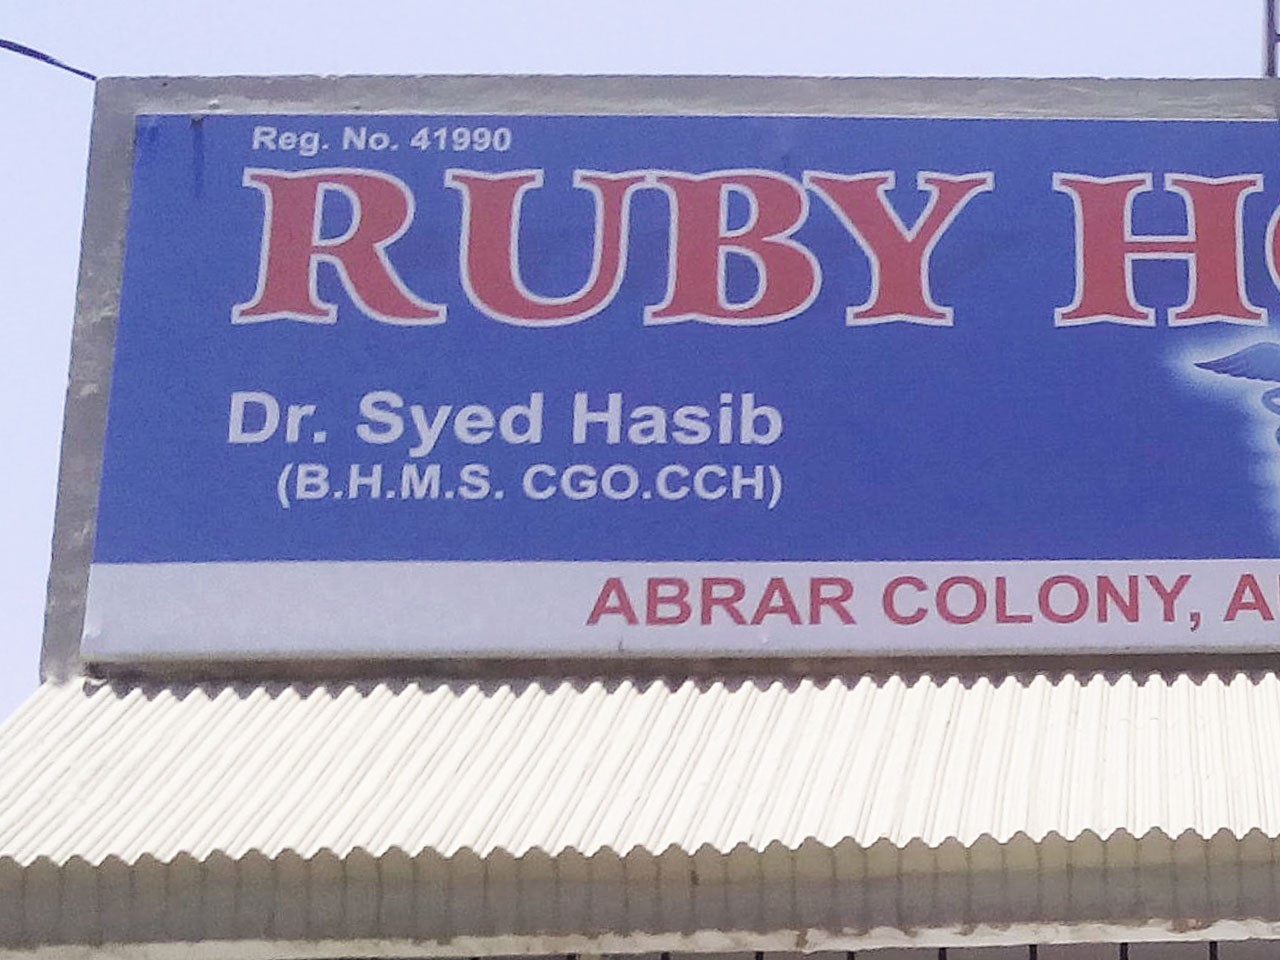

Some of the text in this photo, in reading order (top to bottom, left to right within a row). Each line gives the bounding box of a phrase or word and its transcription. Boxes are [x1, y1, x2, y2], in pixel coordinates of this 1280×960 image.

[252, 126, 513, 157] Reg. No. 41990
[231, 168, 995, 327] RUBY
[227, 391, 783, 457] Dr. Syed Hasib
[277, 463, 783, 509] (B.H.M.S. CGO.CCH)
[587, 576, 856, 626] ABRAR
[883, 574, 1201, 632] COLONY,
